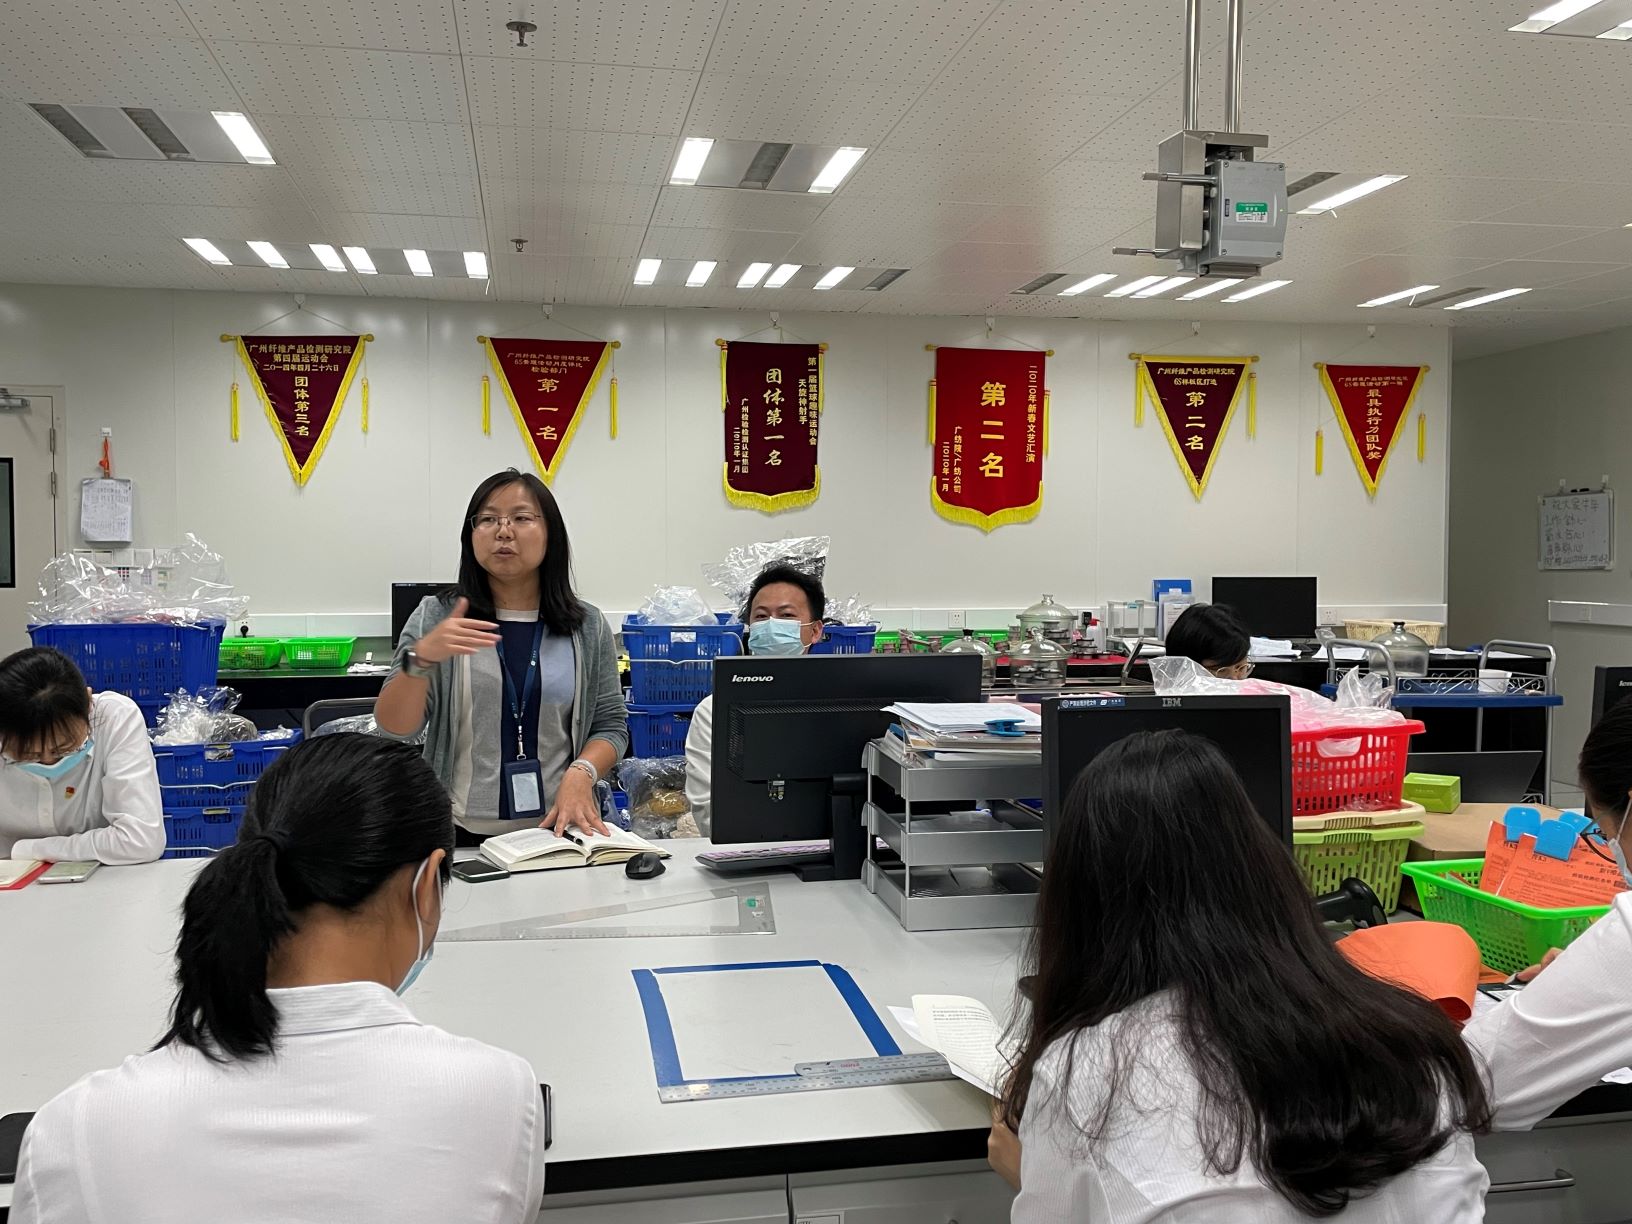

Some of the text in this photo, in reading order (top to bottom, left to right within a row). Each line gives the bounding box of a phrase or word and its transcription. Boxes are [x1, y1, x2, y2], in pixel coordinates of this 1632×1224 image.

[249, 344, 352, 354] 广州纤维产品检测研究院
[273, 354, 329, 363] 第四届运动会
[293, 376, 310, 437] 团体第三名
[536, 378, 560, 440] 第一名
[763, 368, 785, 466] 团体第一名
[979, 381, 1006, 478] 第二名
[1185, 391, 1206, 450] 第二名
[1365, 389, 1383, 460] 最具执行力团队奖
[732, 674, 774, 682] lenovo
[1162, 697, 1182, 708] IBM
